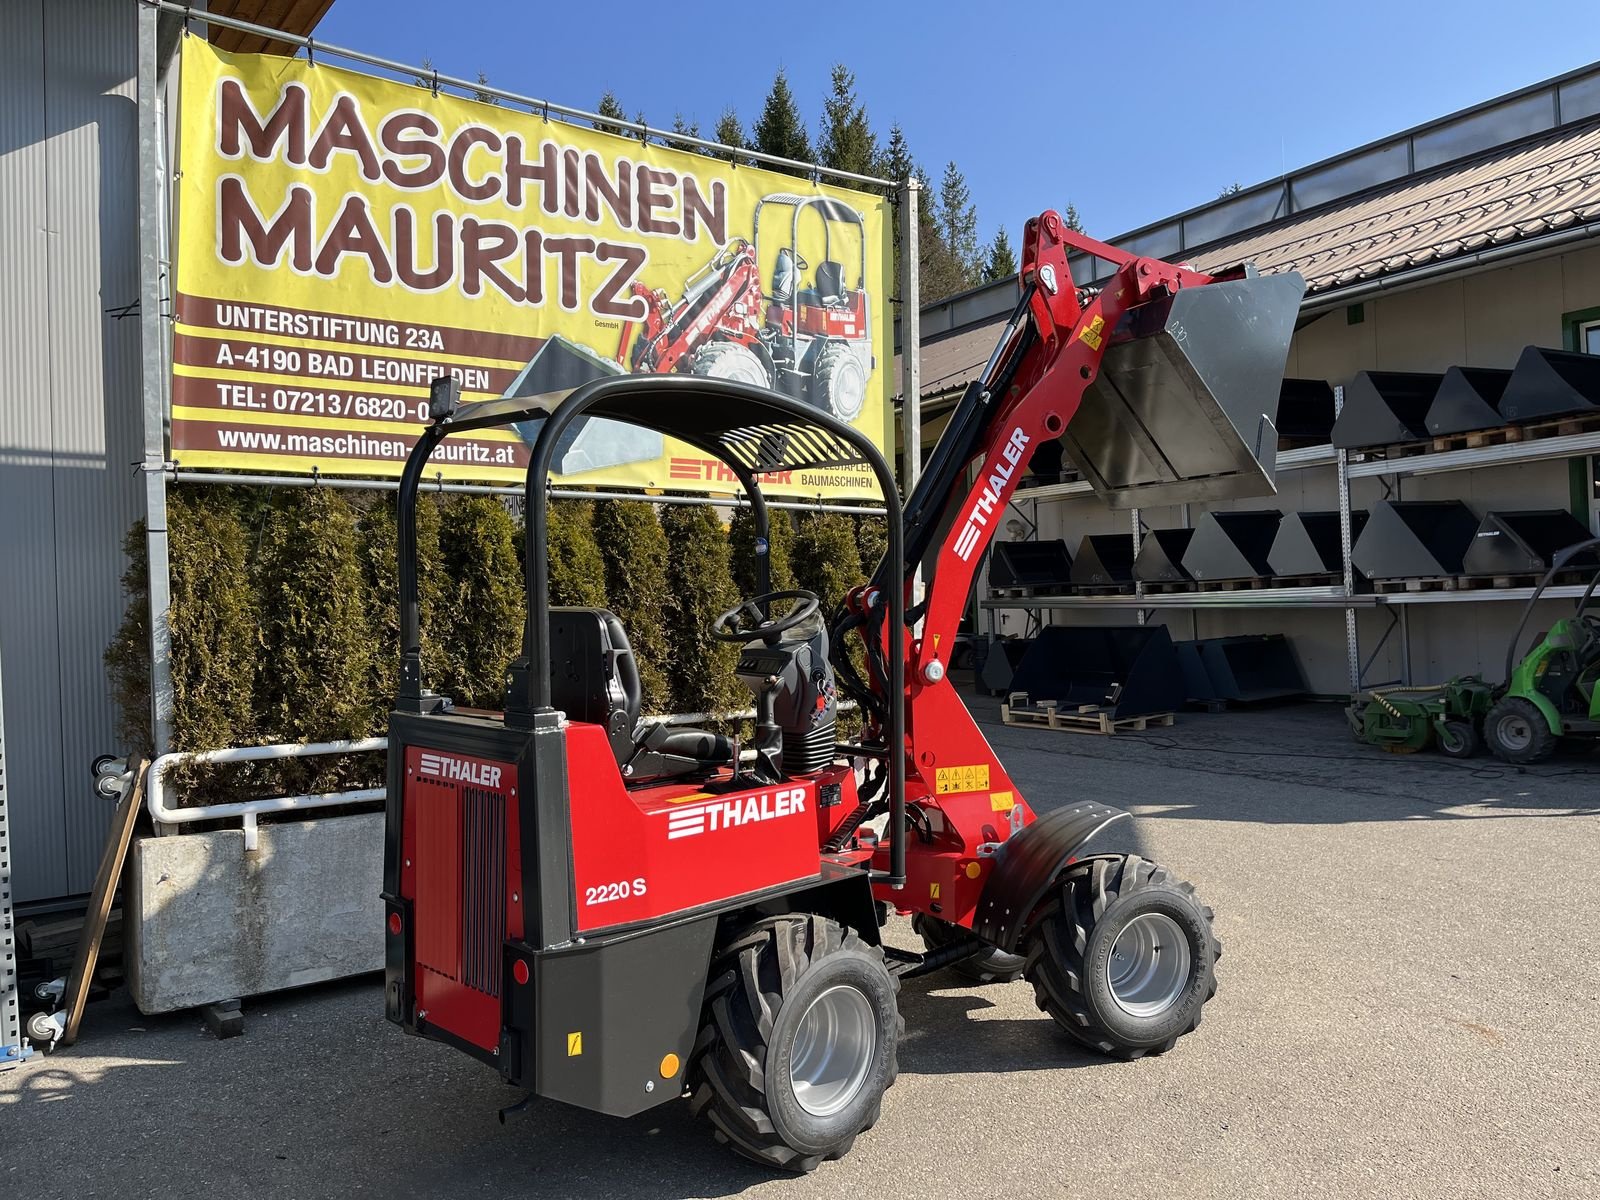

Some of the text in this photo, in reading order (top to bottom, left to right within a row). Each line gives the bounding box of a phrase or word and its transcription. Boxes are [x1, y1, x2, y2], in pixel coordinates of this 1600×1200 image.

[219, 79, 726, 246] MASCHINEN
[219, 176, 647, 318] MAURITZ
[217, 305, 445, 350] UNTERSTIFTUNG 23A
[216, 343, 301, 372] A-4190
[308, 354, 354, 377] BAD
[216, 383, 267, 409] TEL:
[217, 429, 515, 465] www.maschinen-auritz.at
[801, 474, 873, 488] BAUMASCHINEN
[585, 877, 647, 906] 2220 S
